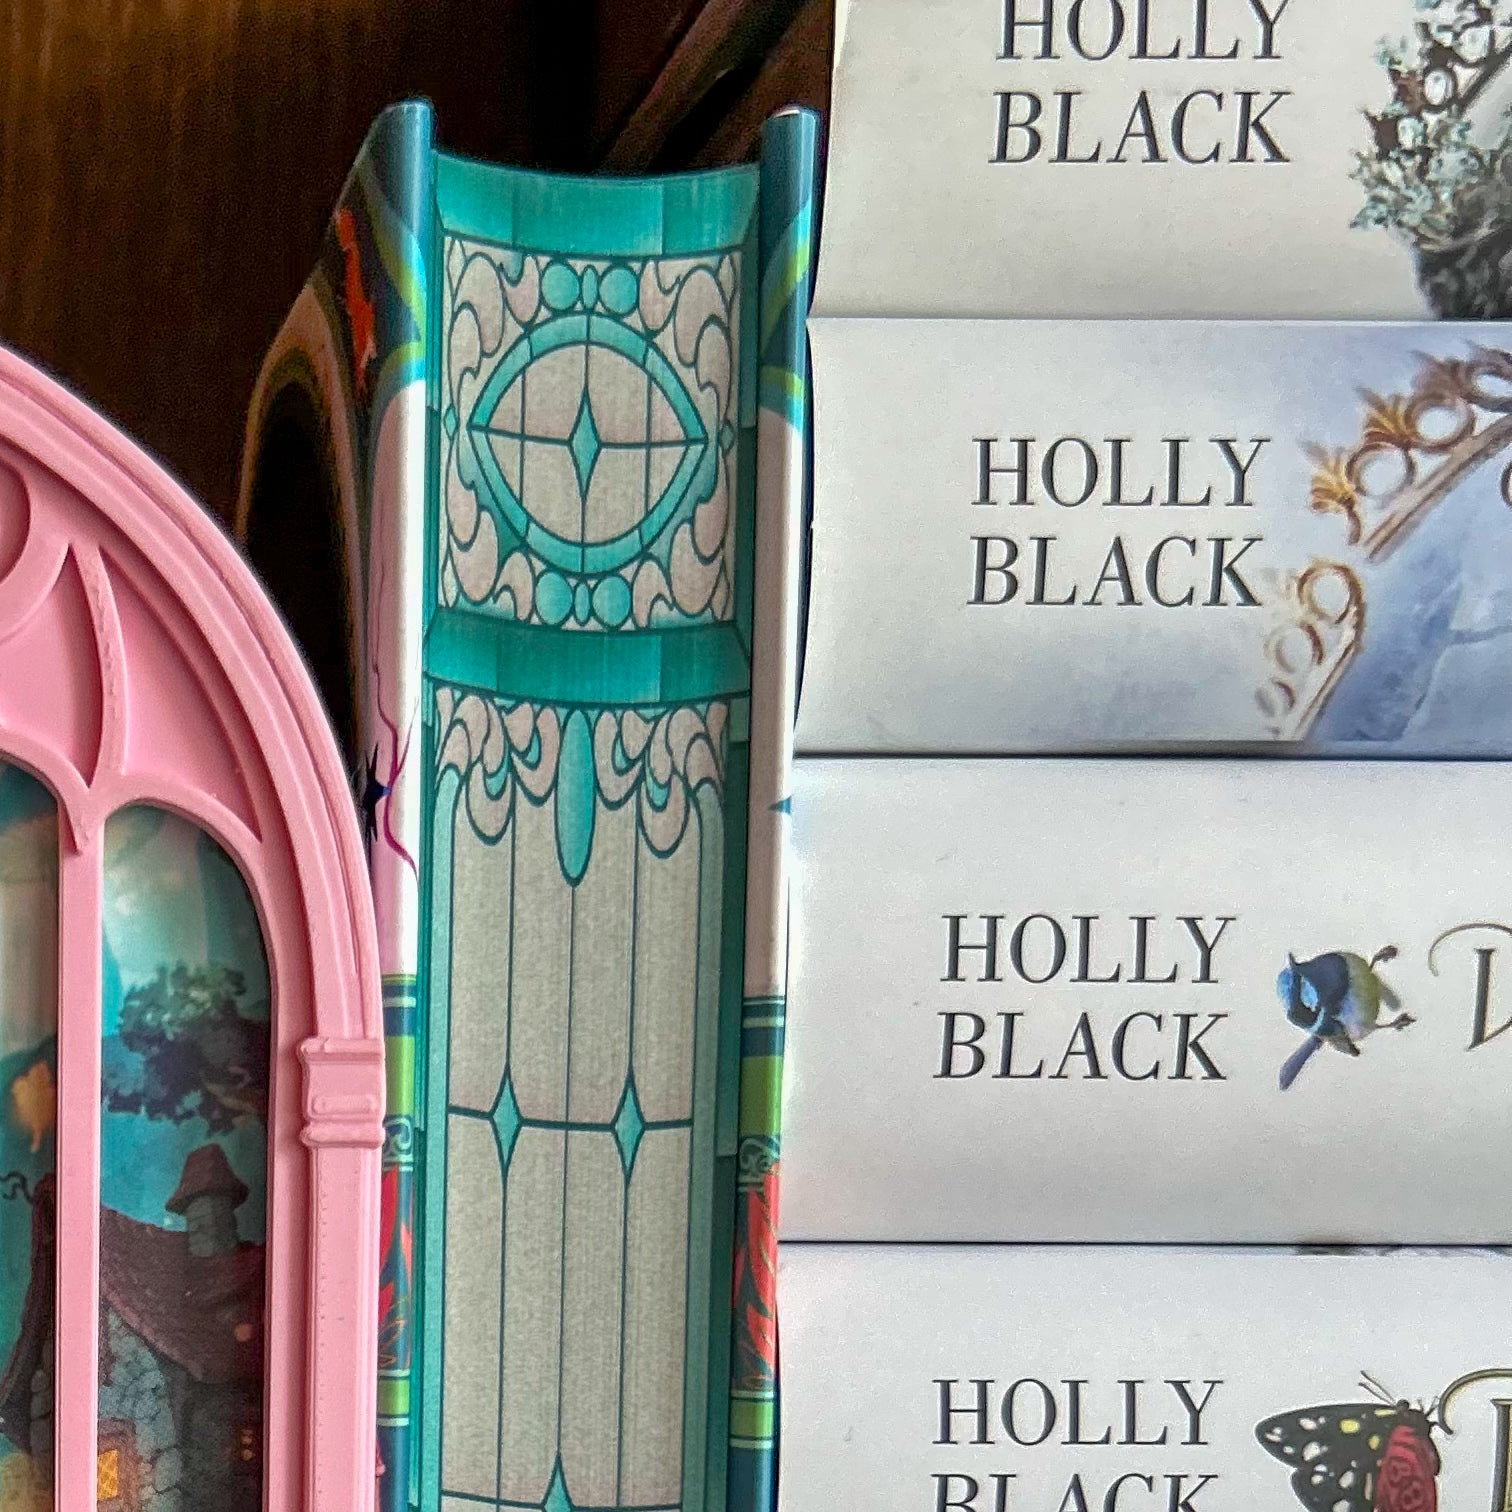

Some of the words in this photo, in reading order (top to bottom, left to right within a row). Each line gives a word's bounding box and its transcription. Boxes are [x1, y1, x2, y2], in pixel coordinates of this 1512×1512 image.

[996, 0, 1290, 61] HOLLY
[988, 89, 1293, 164] BLACK
[971, 436, 1272, 508] HOLLY
[966, 536, 1264, 608] BLACK
[940, 914, 1237, 984] HOLLY
[933, 1012, 1229, 1080] BLACK
[931, 1378, 1225, 1446] HOLLY
